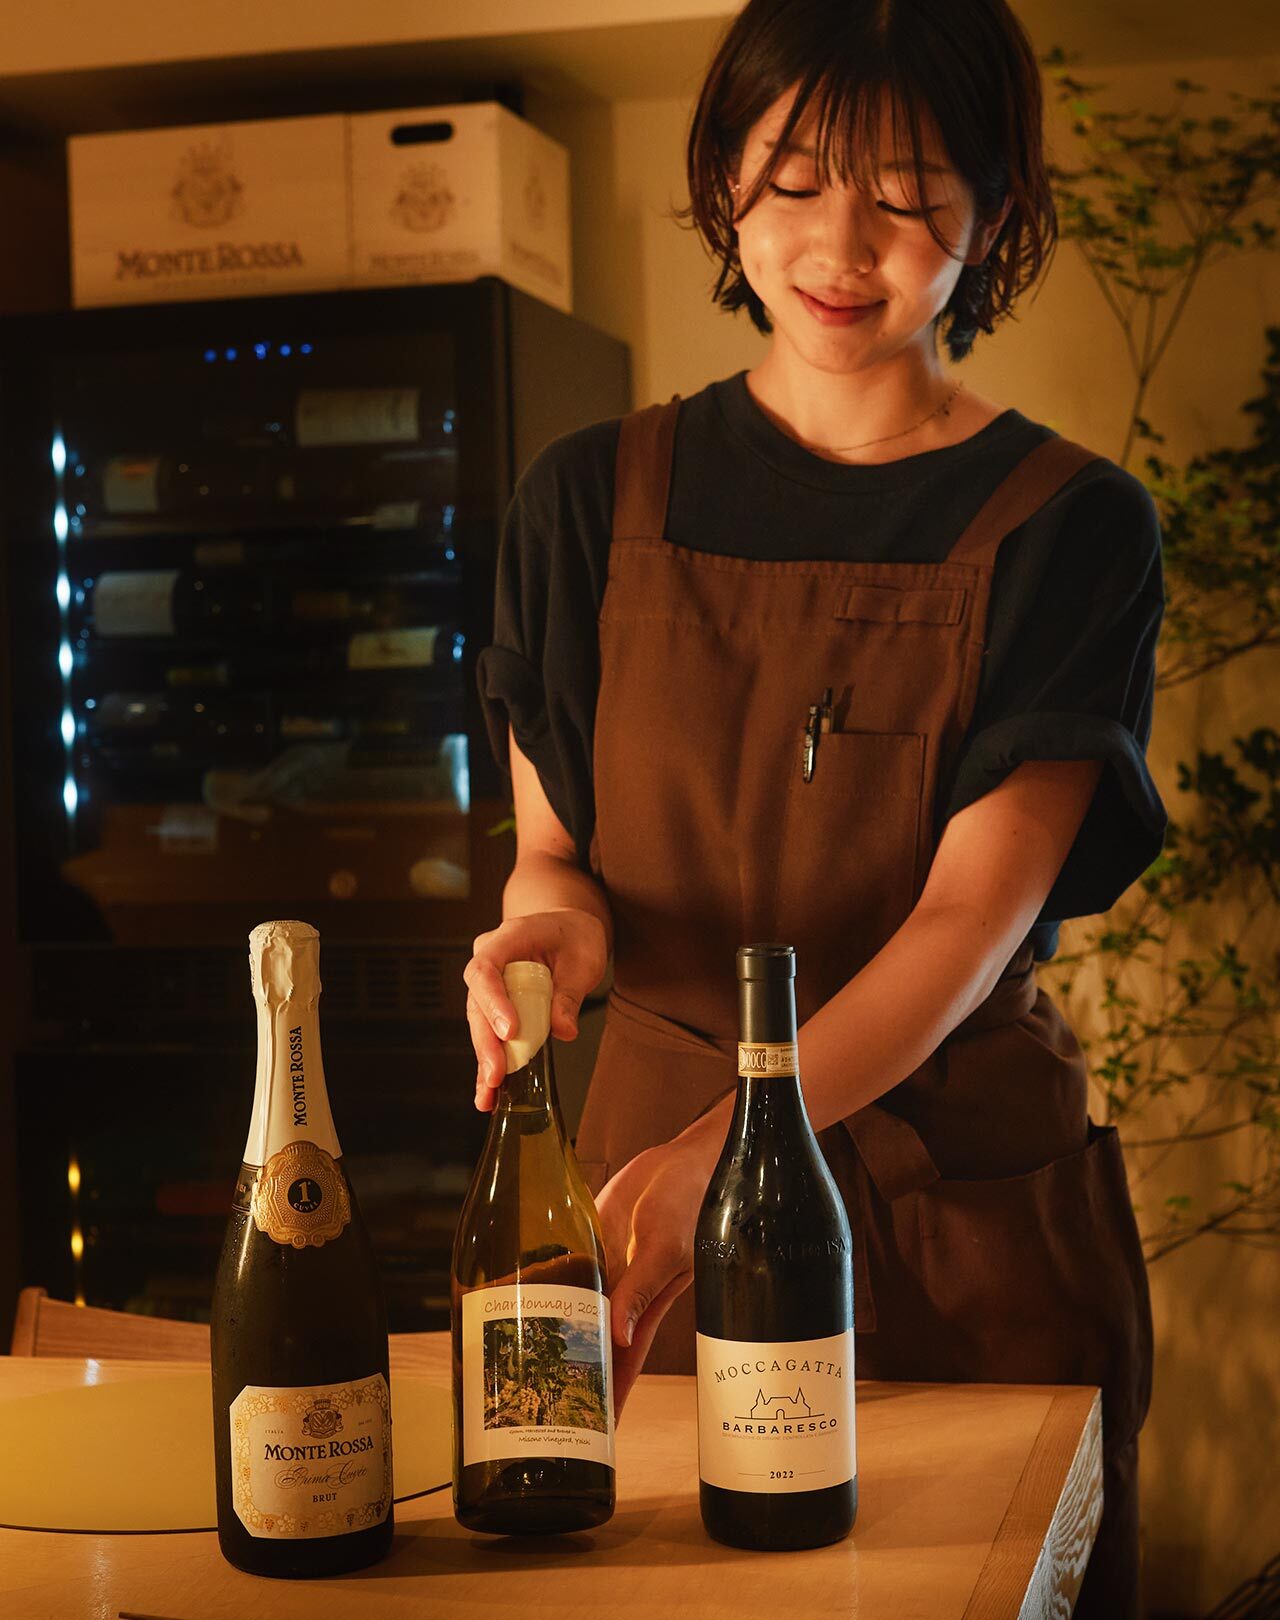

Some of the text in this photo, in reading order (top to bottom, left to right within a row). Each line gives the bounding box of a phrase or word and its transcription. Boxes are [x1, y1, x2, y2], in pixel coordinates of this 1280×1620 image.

[577, 1302, 605, 1317] 202
[713, 1359, 843, 1383] MOCCAGATTA
[722, 1418, 837, 1434] BARBARESCO
[264, 1436, 374, 1461] MONTE ROSSA
[769, 1470, 795, 1479] 2022
[312, 1492, 338, 1503] BRUT
